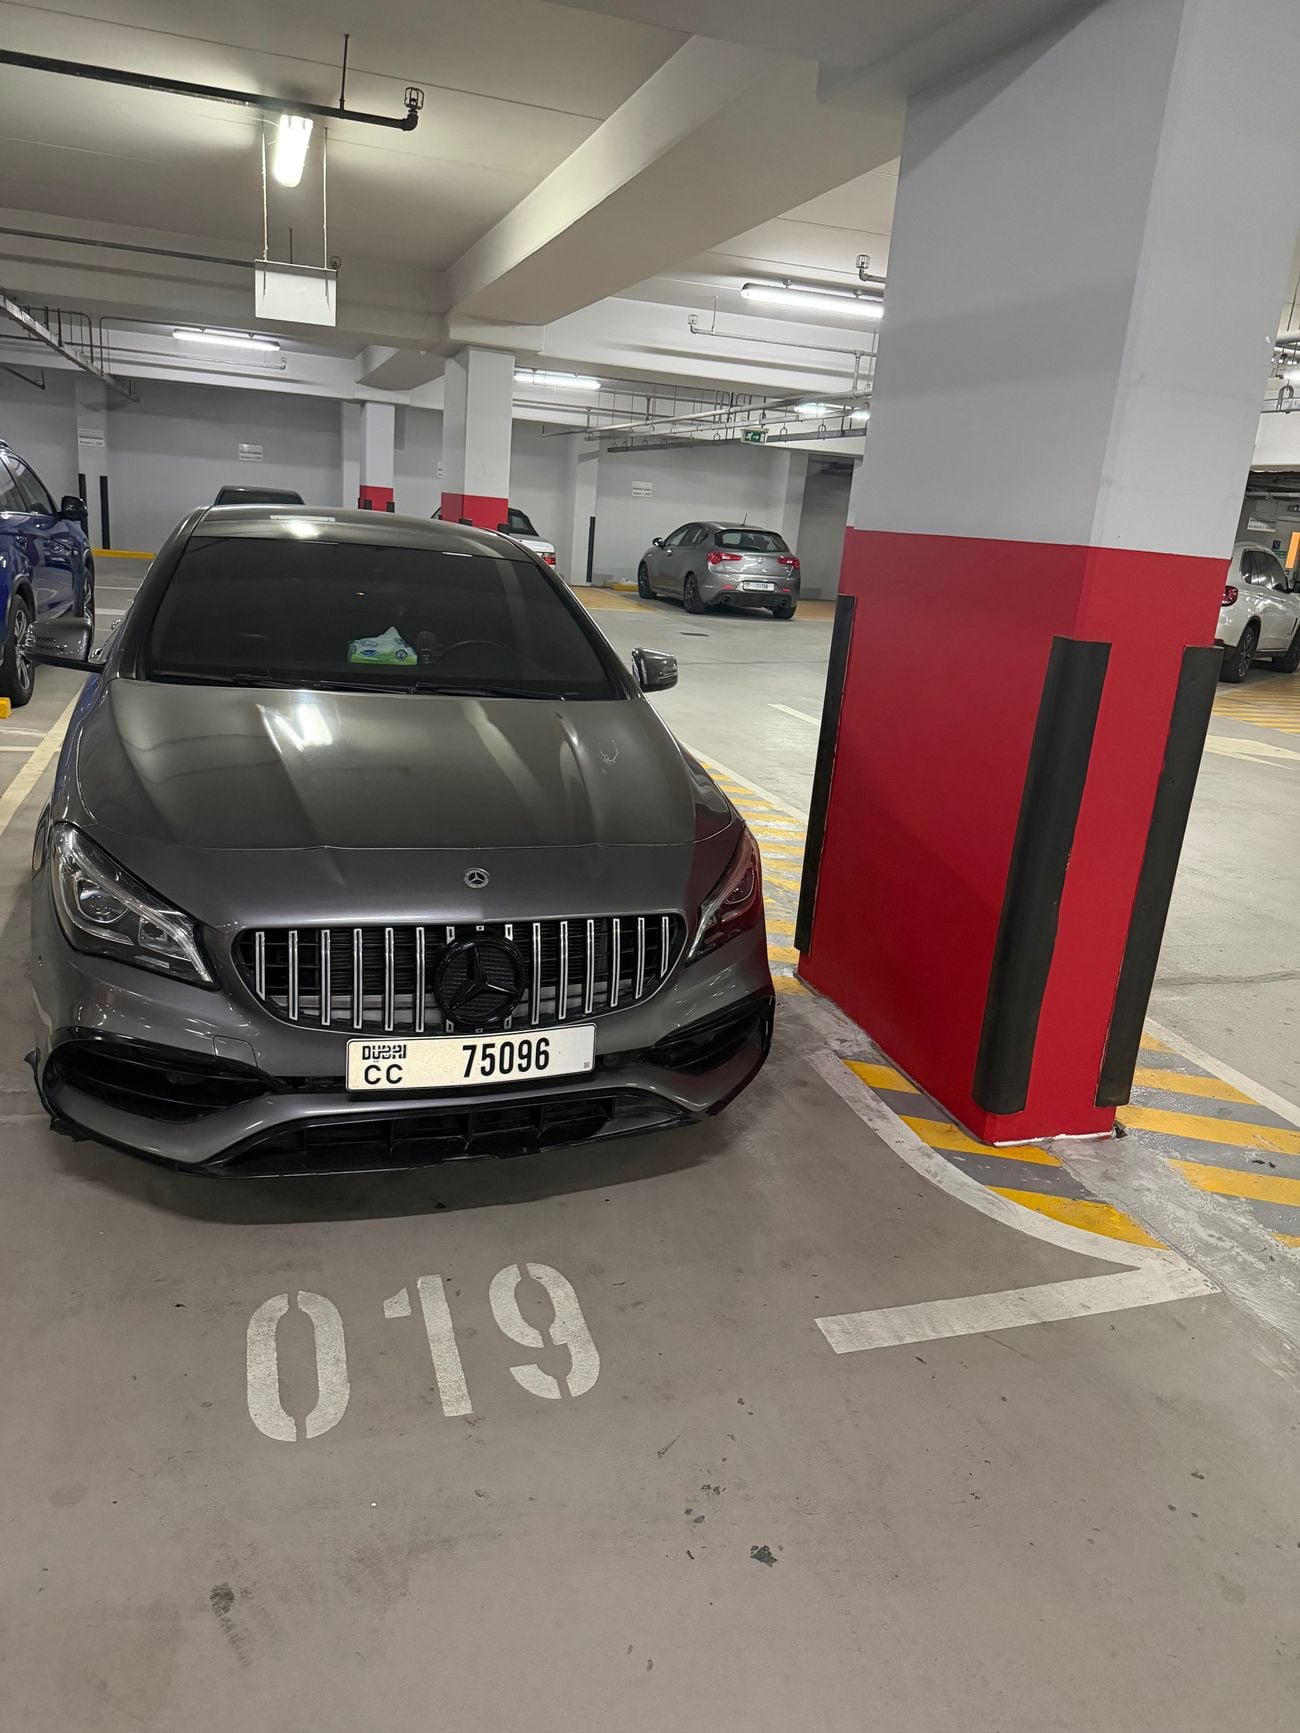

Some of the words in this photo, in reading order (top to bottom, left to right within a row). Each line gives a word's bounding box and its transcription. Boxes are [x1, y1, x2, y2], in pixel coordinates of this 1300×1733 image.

[361, 1044, 407, 1060] DUBAI
[462, 1038, 550, 1078] 75096
[364, 1064, 402, 1085] CC
[246, 1262, 600, 1441] 019
